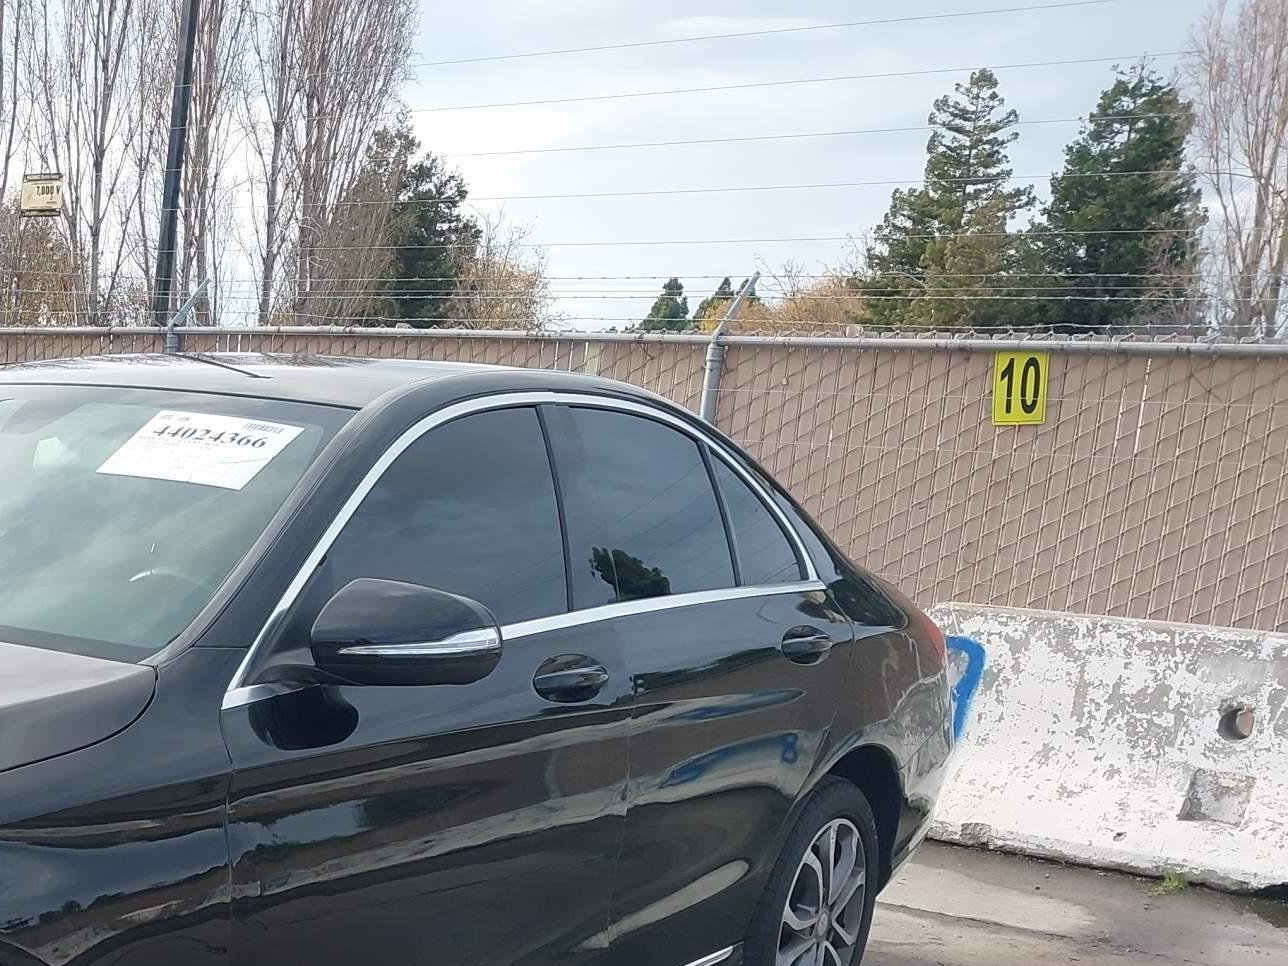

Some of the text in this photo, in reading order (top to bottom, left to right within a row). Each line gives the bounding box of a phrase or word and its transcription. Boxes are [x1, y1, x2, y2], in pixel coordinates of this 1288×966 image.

[36, 185, 55, 197] 7,000
[1000, 357, 1040, 414] 10
[153, 425, 267, 449] 44024366
